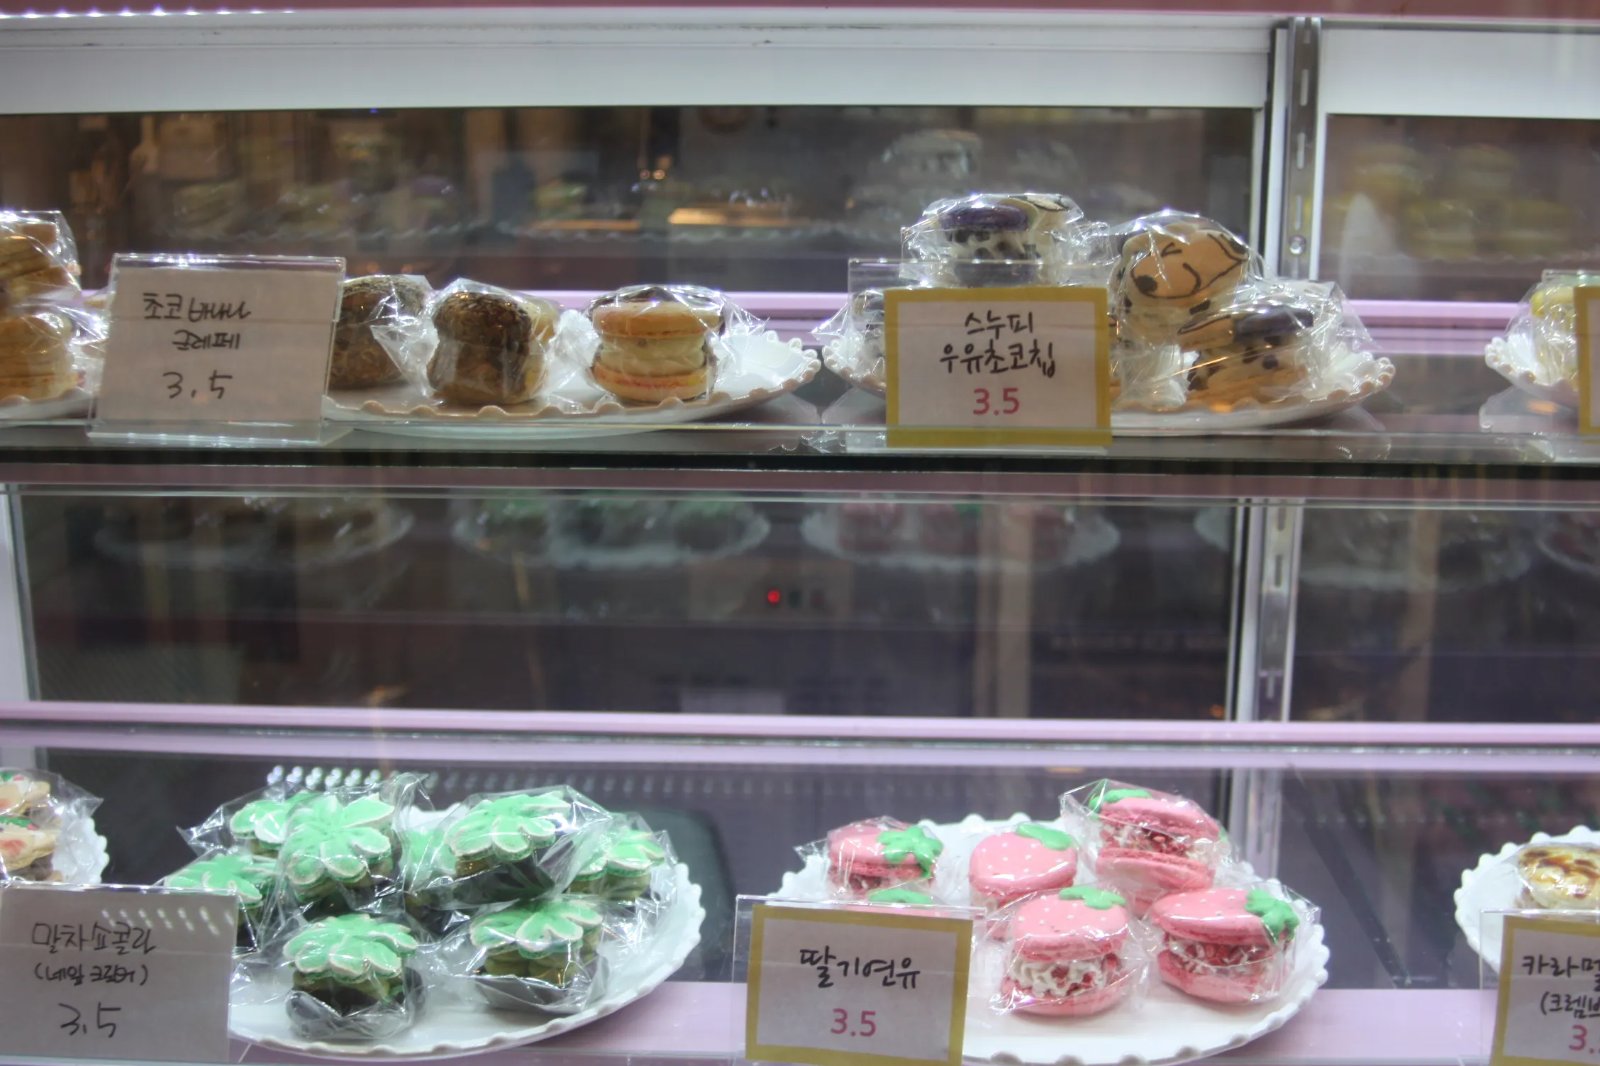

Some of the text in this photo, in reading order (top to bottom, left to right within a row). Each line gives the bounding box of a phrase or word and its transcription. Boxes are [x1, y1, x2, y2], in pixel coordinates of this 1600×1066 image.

[964, 309, 1033, 340] 스누피
[171, 329, 241, 351] 크레페
[940, 338, 1055, 378] 우유초코칩
[162, 370, 233, 399] 3.5
[973, 387, 1019, 415] 3.5
[32, 921, 157, 955] 말차쇼콜라
[800, 945, 921, 989] 딸기연유
[58, 1001, 121, 1038] 3.5
[830, 1008, 876, 1037] 3.5
[1568, 1024, 1600, 1054] 3.
